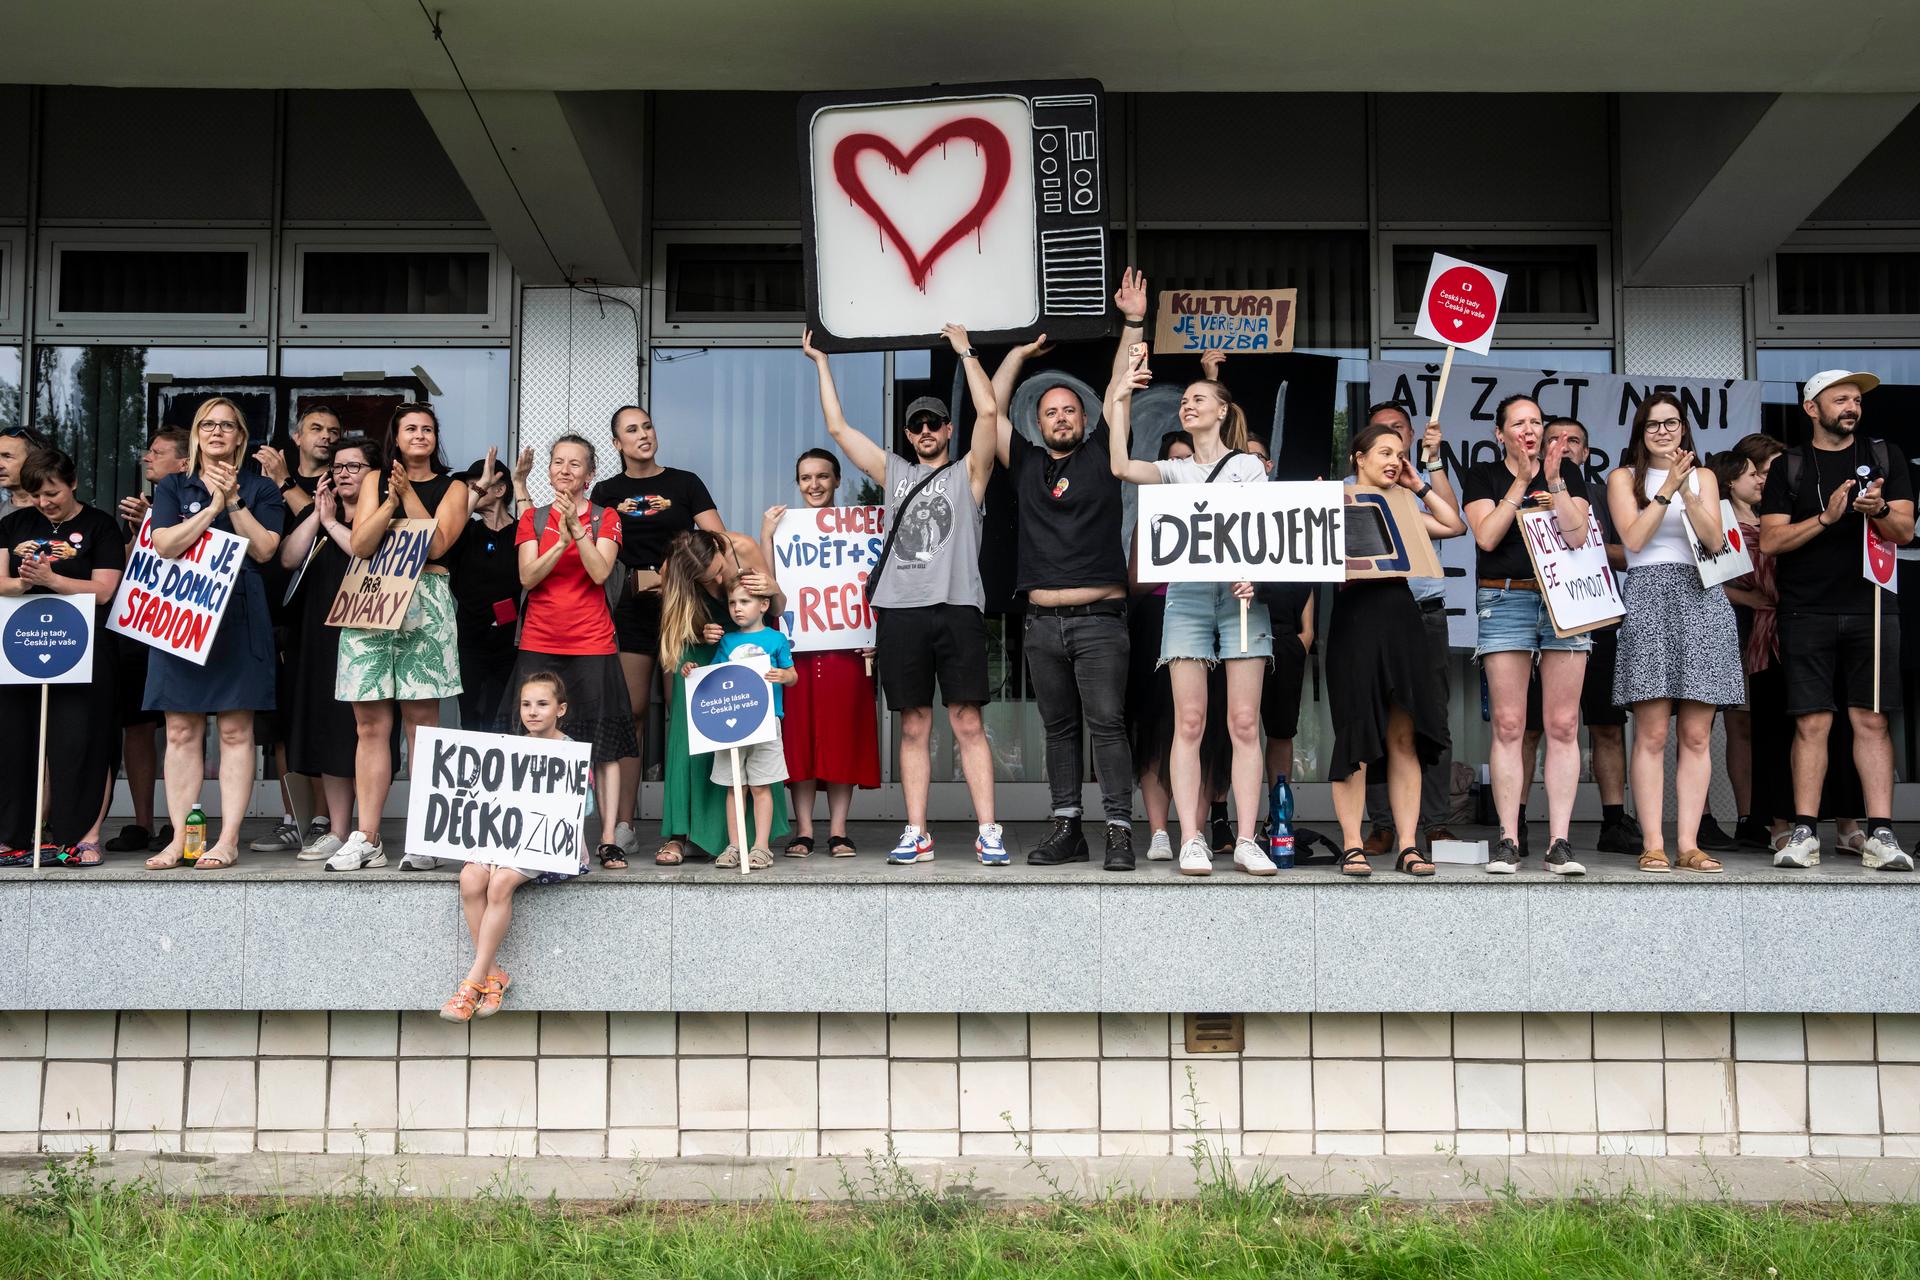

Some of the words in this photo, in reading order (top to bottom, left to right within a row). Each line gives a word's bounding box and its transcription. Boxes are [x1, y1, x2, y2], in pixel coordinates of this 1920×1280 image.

[1171, 292, 1273, 316] KULTURA
[1440, 289, 1459, 302] Česká
[1466, 299, 1480, 309] tady
[1445, 300, 1464, 313] Česká
[1173, 316, 1195, 335] JE
[1470, 376, 1498, 421] Z
[1531, 369, 1589, 423] ČT
[1618, 379, 1735, 430] NNÍ
[1150, 500, 1344, 566] DĚKUJEME
[210, 538, 240, 575] JE
[1543, 562, 1561, 590] SE
[118, 587, 213, 653] STADION
[15, 628, 40, 638] Česká
[40, 629, 48, 638] je
[49, 629, 67, 638] tady
[23, 637, 48, 647] Česká
[49, 638, 57, 647] je
[58, 638, 77, 646] vaše
[700, 697, 723, 708] Česká
[731, 692, 750, 703] láska
[710, 704, 733, 715] Česká
[741, 700, 759, 708] vaše
[431, 739, 505, 793] KDO
[511, 751, 589, 796] VYPNE
